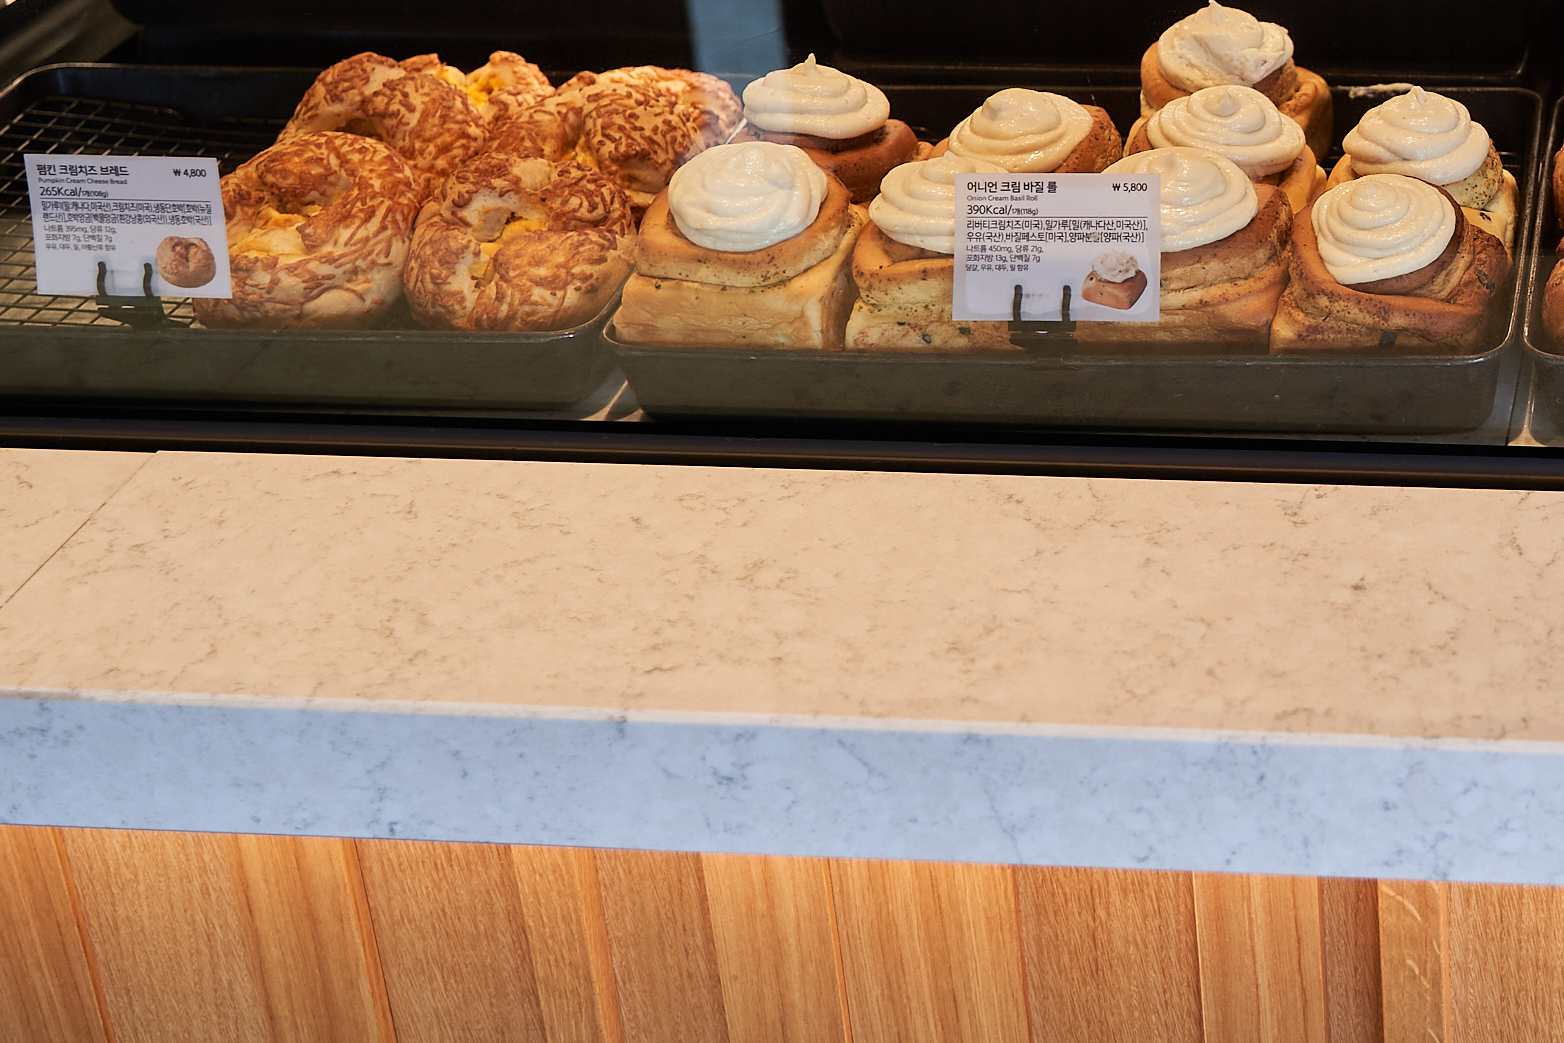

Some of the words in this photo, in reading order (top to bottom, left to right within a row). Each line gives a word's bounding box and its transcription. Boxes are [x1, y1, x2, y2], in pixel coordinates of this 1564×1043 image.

[37, 164, 56, 176] 펌킨
[59, 165, 98, 176] 크림치즈
[100, 166, 129, 176] 브레드
[183, 169, 206, 178] 4,800
[967, 182, 998, 193] 어니언
[1000, 182, 1020, 193] 크림
[1024, 181, 1044, 193] 바질
[1047, 182, 1057, 193] 롤
[1123, 183, 1147, 193] 5,800
[1032, 255, 1040, 263] 7g
